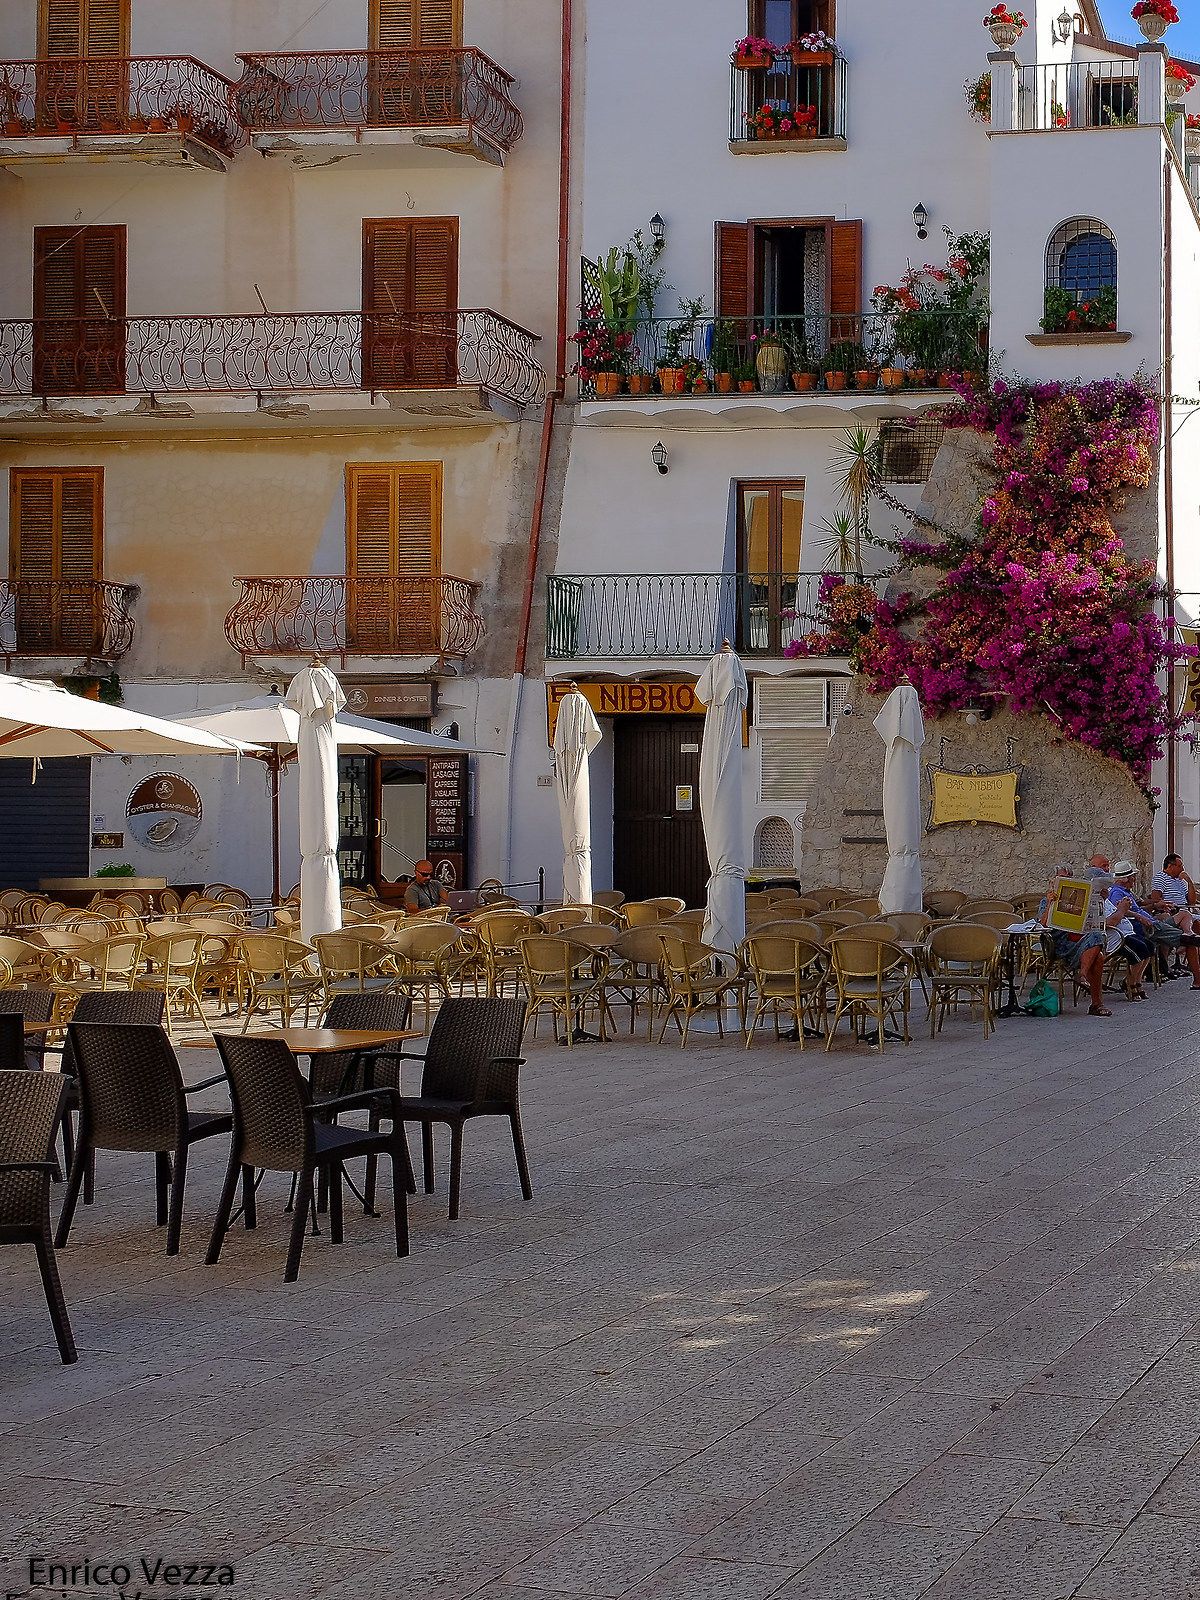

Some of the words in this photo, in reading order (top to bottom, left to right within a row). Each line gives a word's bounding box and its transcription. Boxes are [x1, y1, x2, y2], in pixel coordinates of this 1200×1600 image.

[600, 684, 695, 712] NIBBIO
[432, 762, 460, 770] ANTIPASTI
[432, 770, 460, 779] LASAGNE
[434, 780, 458, 788] CAPRESE
[945, 777, 965, 791] BAR
[968, 778, 1003, 791] NIBBIO
[431, 799, 461, 807] BRUSCHETTE
[130, 803, 155, 813] OYSTER
[160, 802, 198, 813] CHAMPAGNE
[435, 808, 457, 816] PIADINE
[444, 840, 456, 848] BAR
